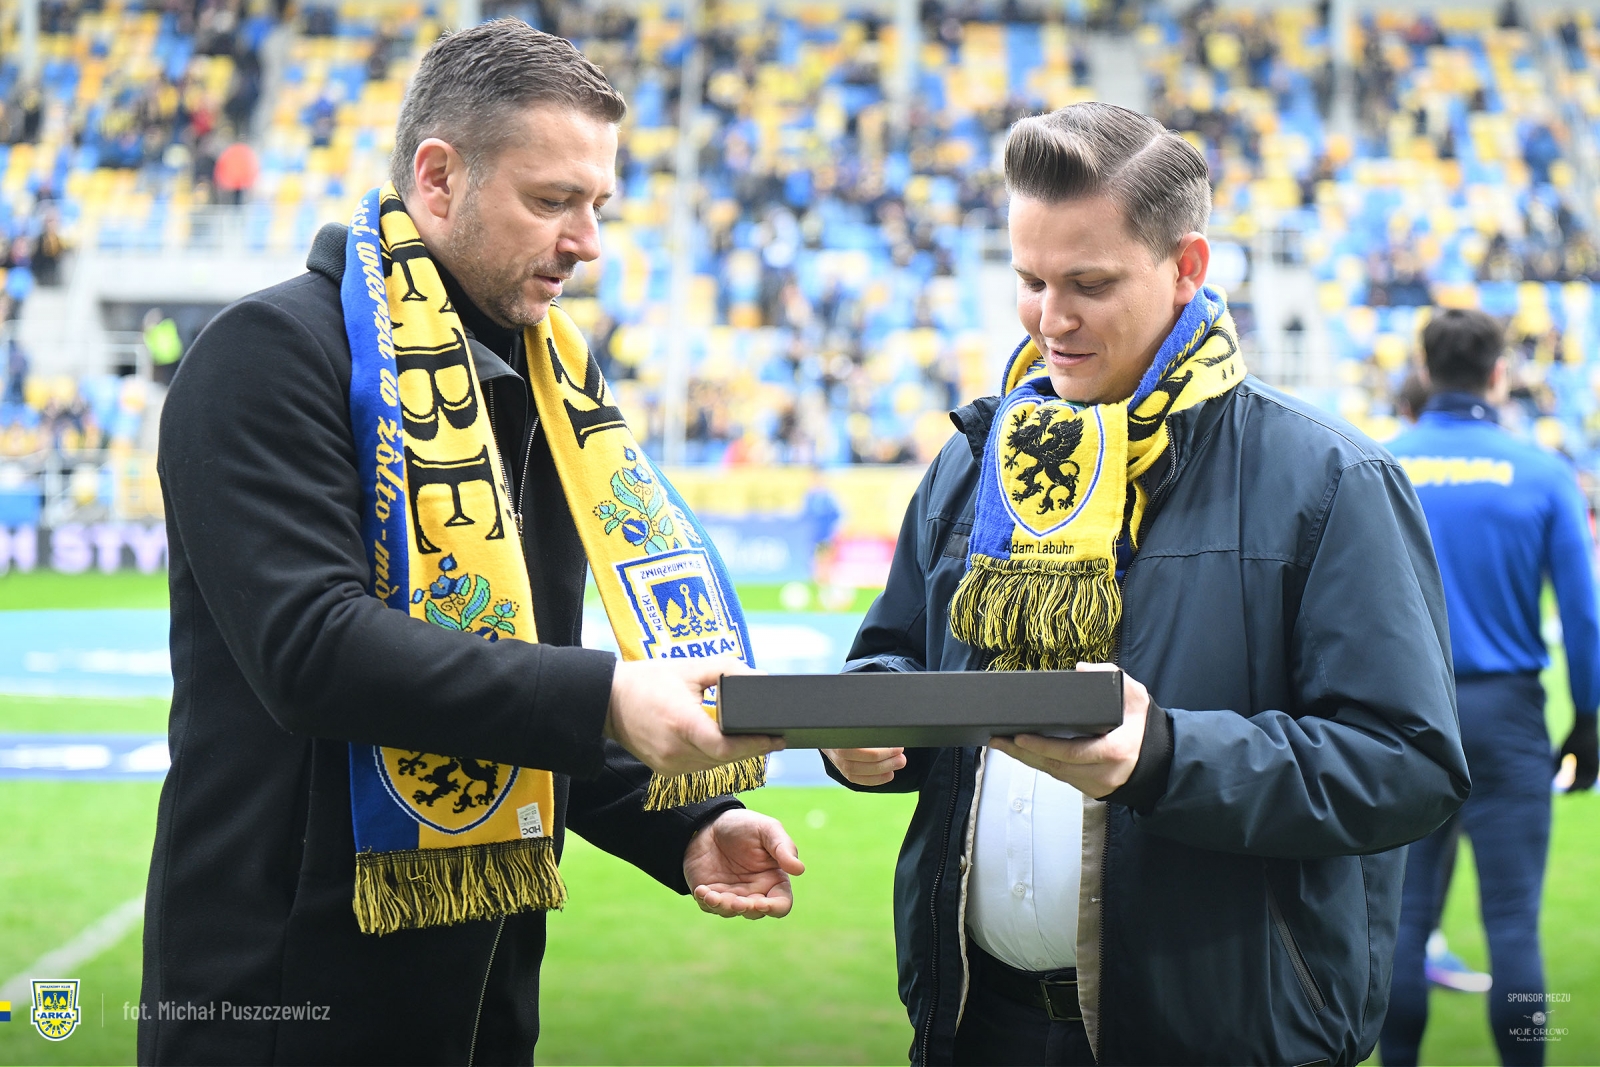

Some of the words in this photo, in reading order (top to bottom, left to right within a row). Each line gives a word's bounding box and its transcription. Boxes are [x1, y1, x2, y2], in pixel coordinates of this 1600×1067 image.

[1002, 540, 1035, 554] Adam
[1037, 540, 1075, 555] Labuhn
[641, 594, 664, 631] MORSKI
[670, 637, 730, 659] ARKA
